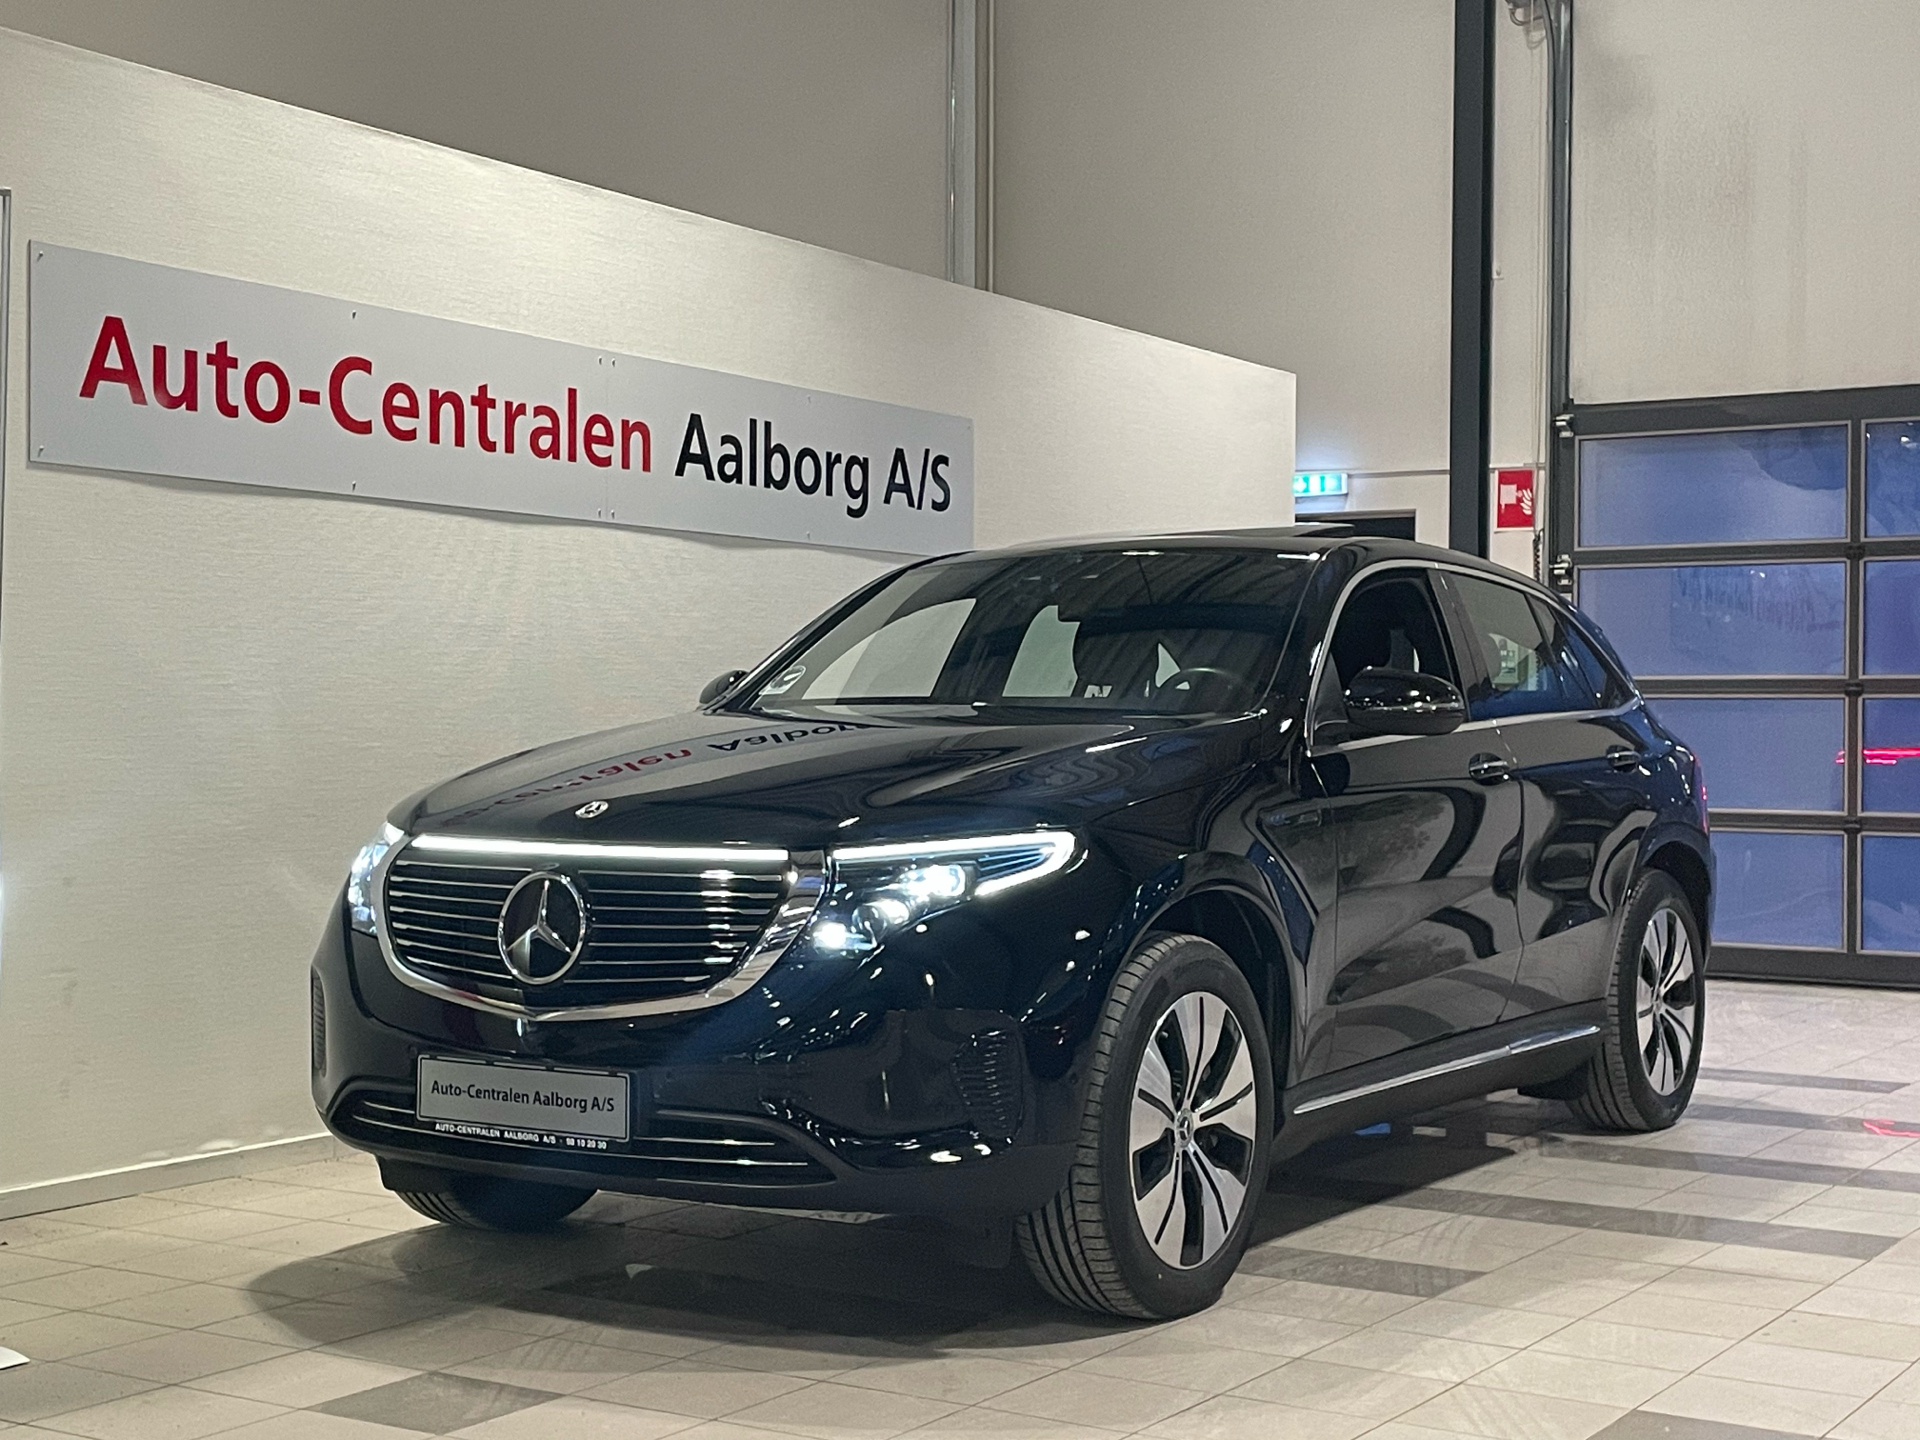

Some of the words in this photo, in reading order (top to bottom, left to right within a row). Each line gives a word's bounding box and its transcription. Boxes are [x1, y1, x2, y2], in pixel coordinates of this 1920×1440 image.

[79, 315, 652, 473] Auto-Centralen
[674, 413, 870, 519] Aalborg
[883, 447, 952, 512] A/S
[430, 1080, 530, 1105] Auto-Centralen
[532, 1090, 588, 1114] Aalborg
[590, 1096, 615, 1112] A/S
[434, 1122, 501, 1138] AUTO-CENTRALEN
[503, 1130, 540, 1143] AALBORG
[542, 1134, 557, 1145] A/S
